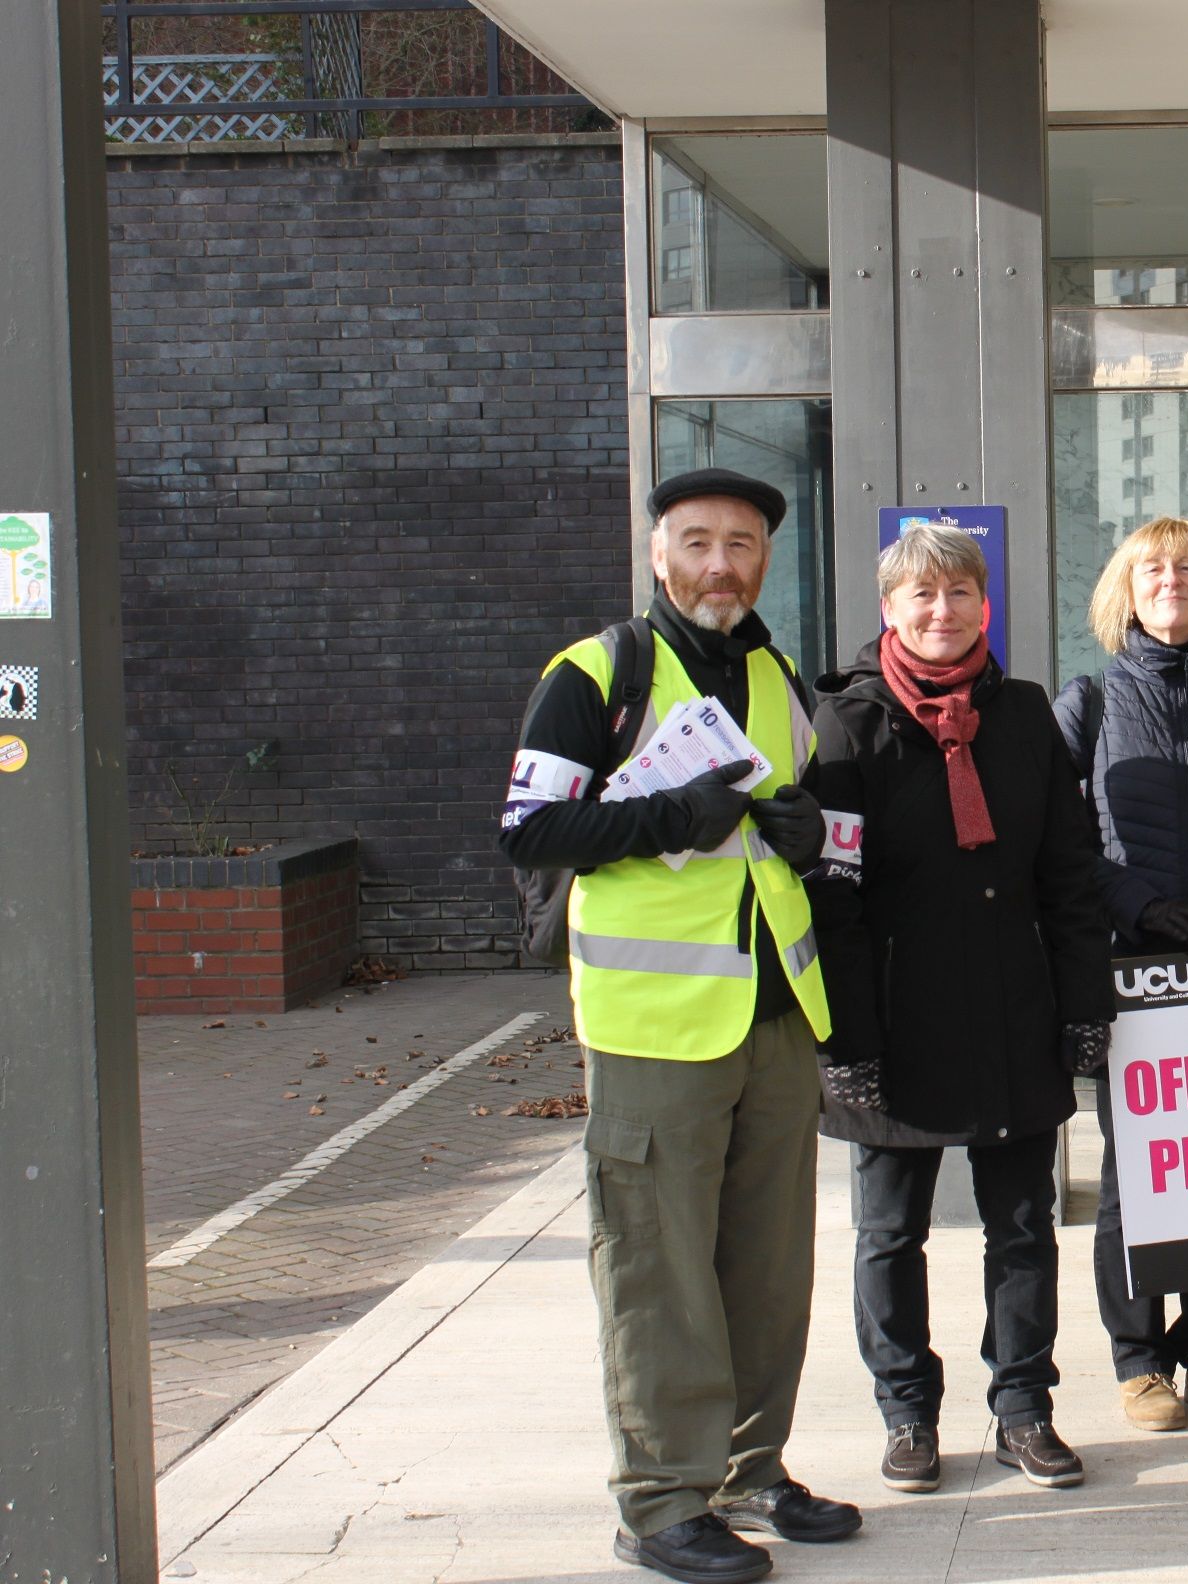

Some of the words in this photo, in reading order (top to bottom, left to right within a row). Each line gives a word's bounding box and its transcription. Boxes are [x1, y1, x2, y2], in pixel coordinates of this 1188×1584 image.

[941, 516, 959, 526] The
[961, 526, 989, 537] ersity
[699, 706, 718, 727] 10
[1143, 994, 1168, 1003] University
